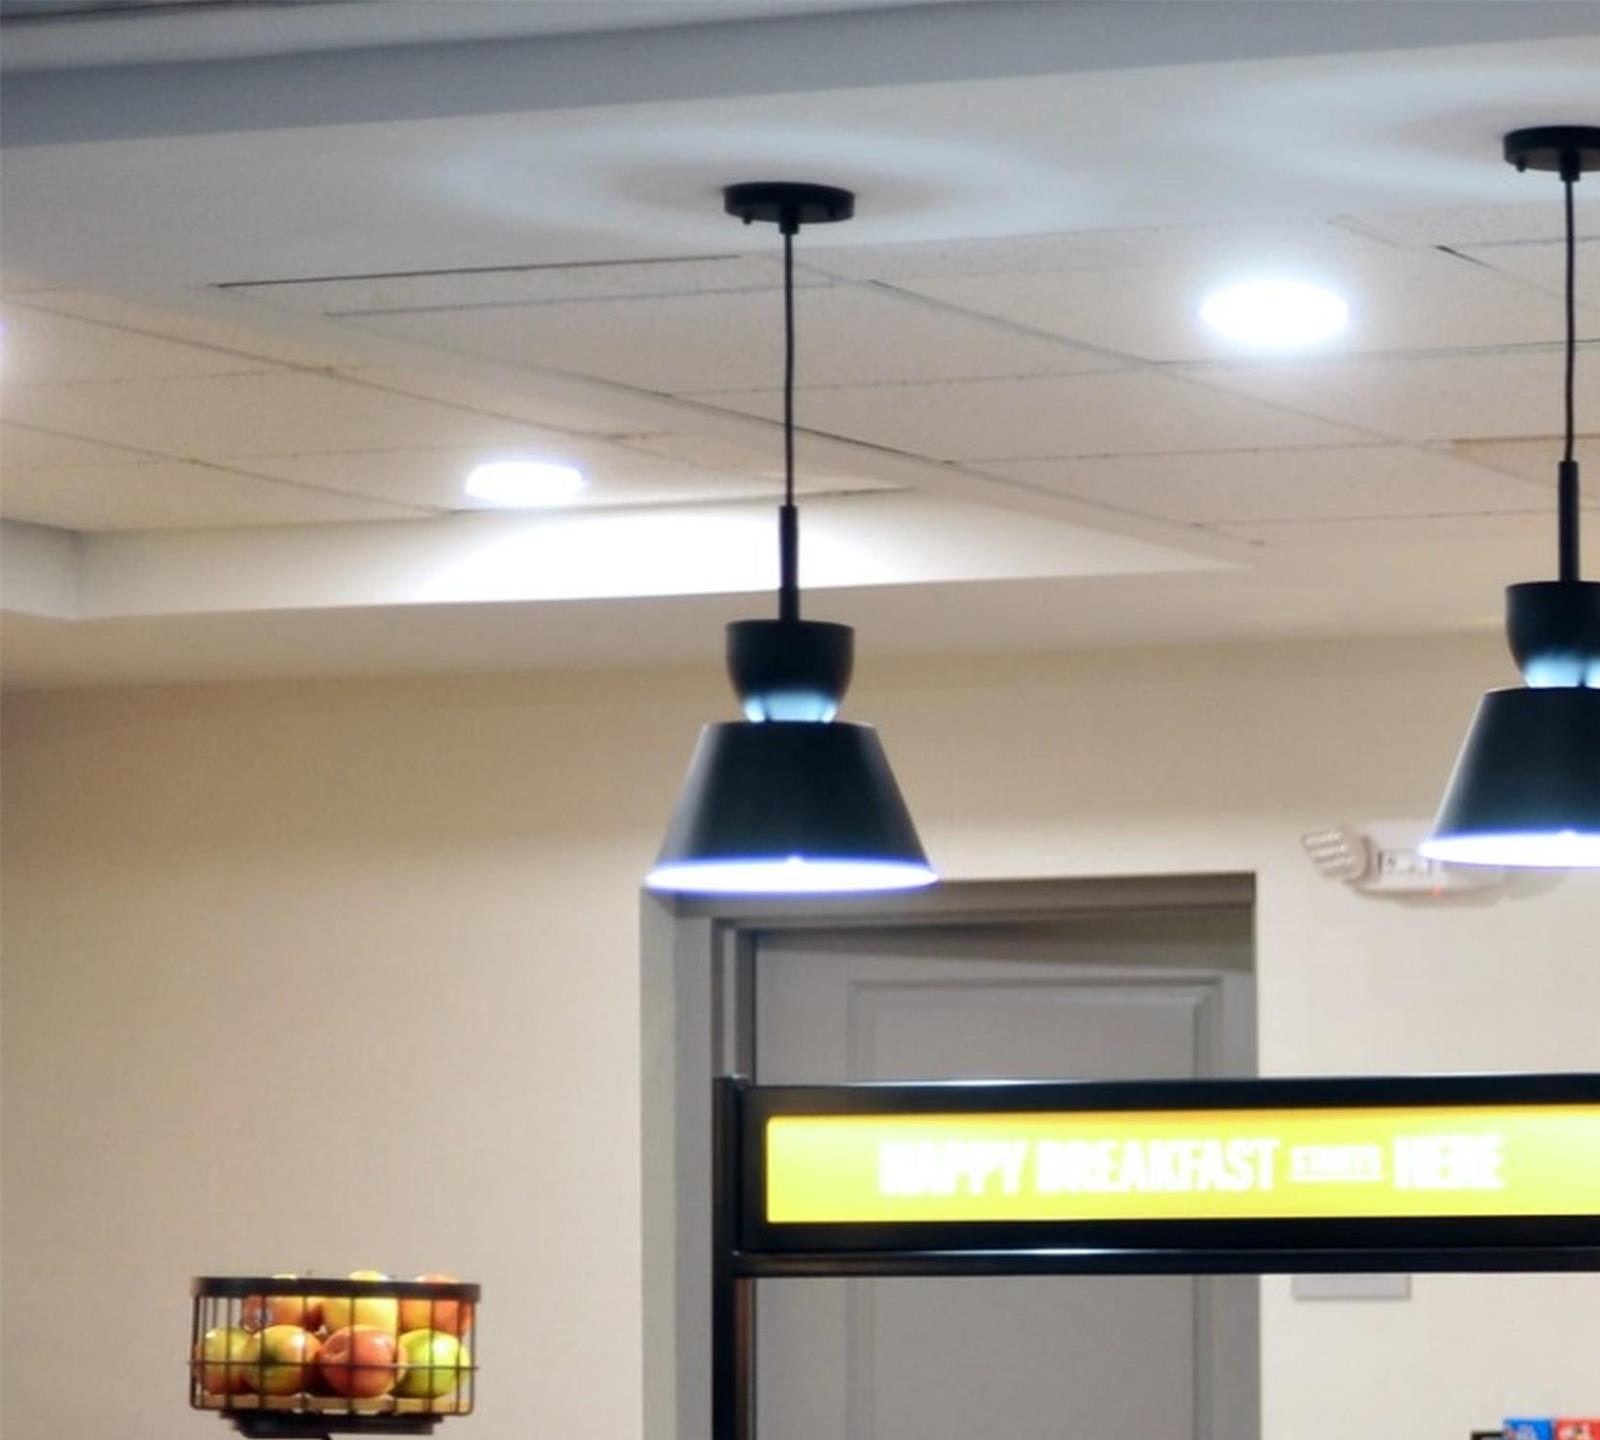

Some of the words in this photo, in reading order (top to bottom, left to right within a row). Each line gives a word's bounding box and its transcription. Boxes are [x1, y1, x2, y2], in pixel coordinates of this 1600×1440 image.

[879, 1138, 1029, 1197] HAPPY
[1034, 1136, 1280, 1195] BREAKFAST
[1393, 1134, 1506, 1191] HERE
